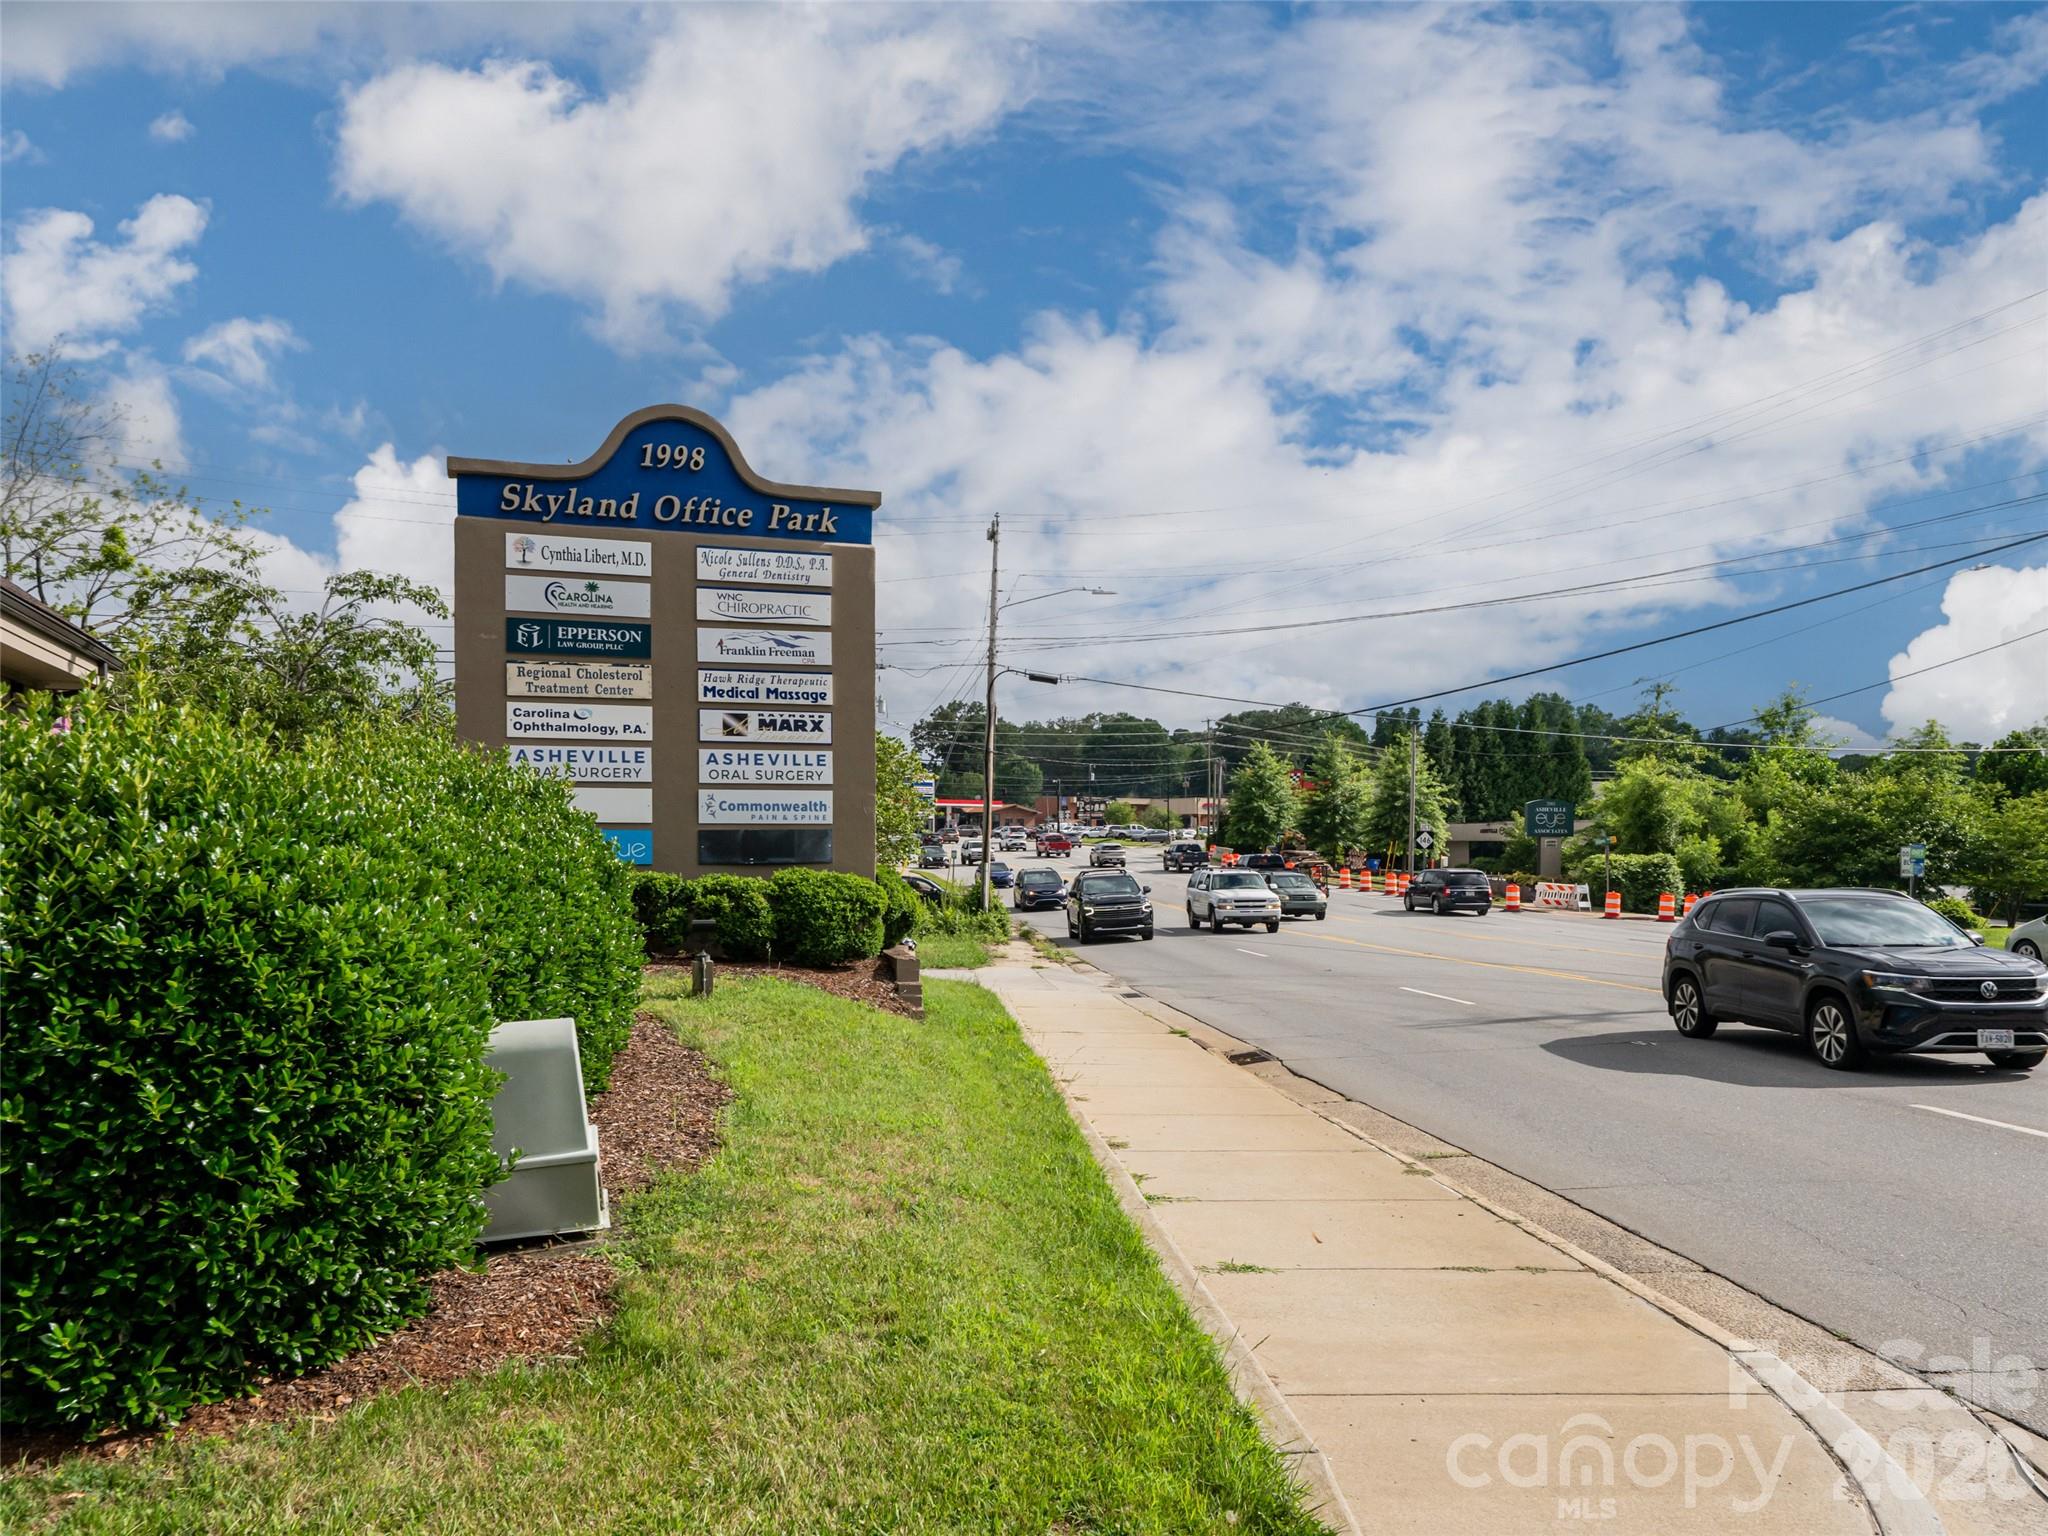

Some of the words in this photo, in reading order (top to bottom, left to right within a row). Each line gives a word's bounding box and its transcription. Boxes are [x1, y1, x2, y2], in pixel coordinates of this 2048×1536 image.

[640, 443, 705, 471] 1998
[500, 483, 641, 522] Skyland
[654, 495, 753, 528] Office
[767, 503, 839, 534] Park
[541, 545, 582, 565] Cynthia
[584, 548, 619, 568] Libert,
[621, 551, 647, 567] M.D.
[701, 550, 732, 567] Nicole
[736, 551, 771, 568] Sullens
[776, 556, 805, 570] D.D.S.,
[809, 558, 828, 571] P.A.
[719, 567, 758, 579] General
[763, 570, 811, 584] Dentistry
[557, 591, 613, 604] CAROLINA
[717, 593, 743, 602] WNC
[717, 601, 811, 617] CHIROPRACTIC
[557, 626, 642, 643] EPPERSON
[576, 642, 604, 650] GROUP,
[719, 646, 766, 656] Franklin
[768, 647, 815, 658] Freeman
[517, 666, 571, 680] Regional
[576, 668, 643, 681] Cholesterol
[703, 673, 732, 683] Hawk
[737, 674, 765, 686] Ridge
[770, 675, 828, 687] Therapeutic
[525, 682, 589, 694] Treatment
[595, 684, 634, 695] Center
[703, 686, 759, 699] Medical
[766, 688, 827, 703] Massage
[513, 708, 570, 719] Carolina
[513, 721, 618, 736] Ophthalmology,
[623, 724, 647, 734] P.A.
[758, 718, 824, 733] MARX
[515, 749, 646, 764] ASHEVILLE
[706, 753, 827, 767] ASHEVILLE
[568, 767, 642, 778] SURGERY
[708, 769, 749, 780] ORAL
[755, 769, 823, 781] SURGERY
[719, 801, 827, 812] Commonwealth
[1536, 812, 1566, 828] eye
